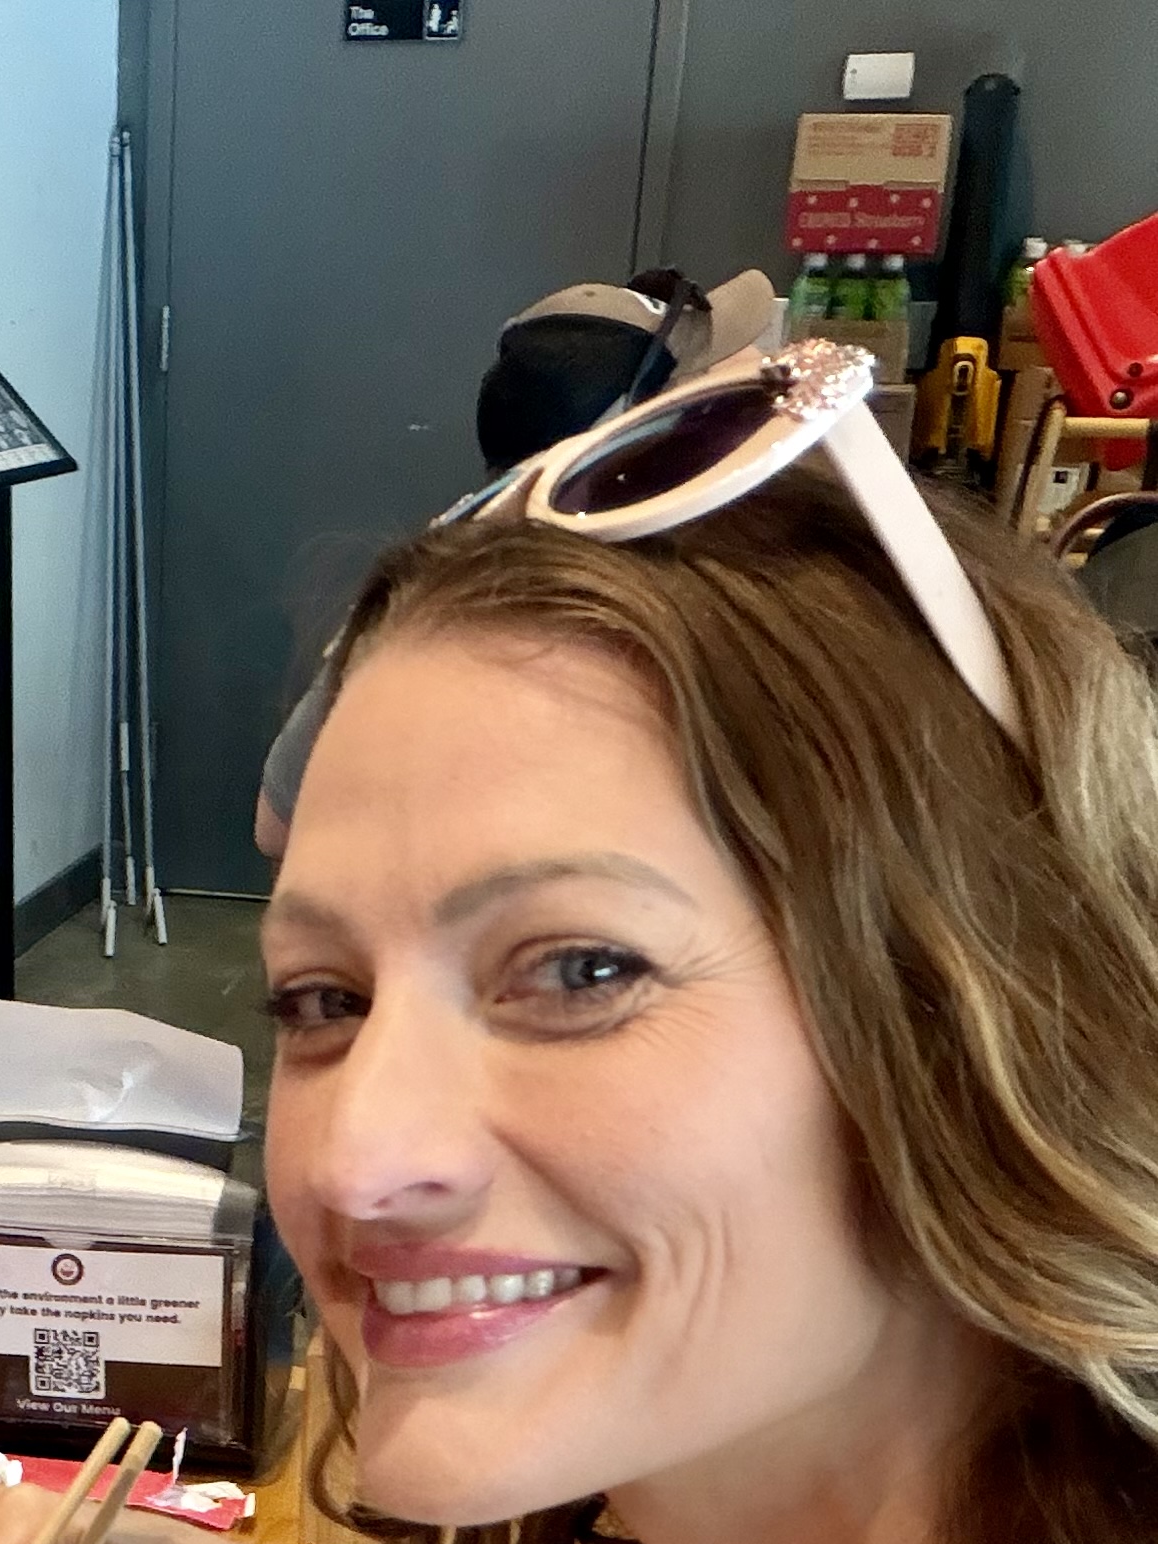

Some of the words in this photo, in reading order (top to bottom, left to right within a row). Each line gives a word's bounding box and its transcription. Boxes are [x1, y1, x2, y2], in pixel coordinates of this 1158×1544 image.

[349, 5, 375, 20] The
[347, 22, 390, 37] Office
[22, 1291, 103, 1304] environment
[105, 1296, 115, 1305] a
[117, 1295, 146, 1306] little
[150, 1298, 200, 1310] greener
[9, 1304, 38, 1316] take
[40, 1306, 61, 1318] the
[64, 1309, 115, 1321] napkins
[118, 1313, 142, 1324] you
[16, 1399, 51, 1412] View
[52, 1402, 79, 1414] Our
[81, 1403, 121, 1416] Menu
